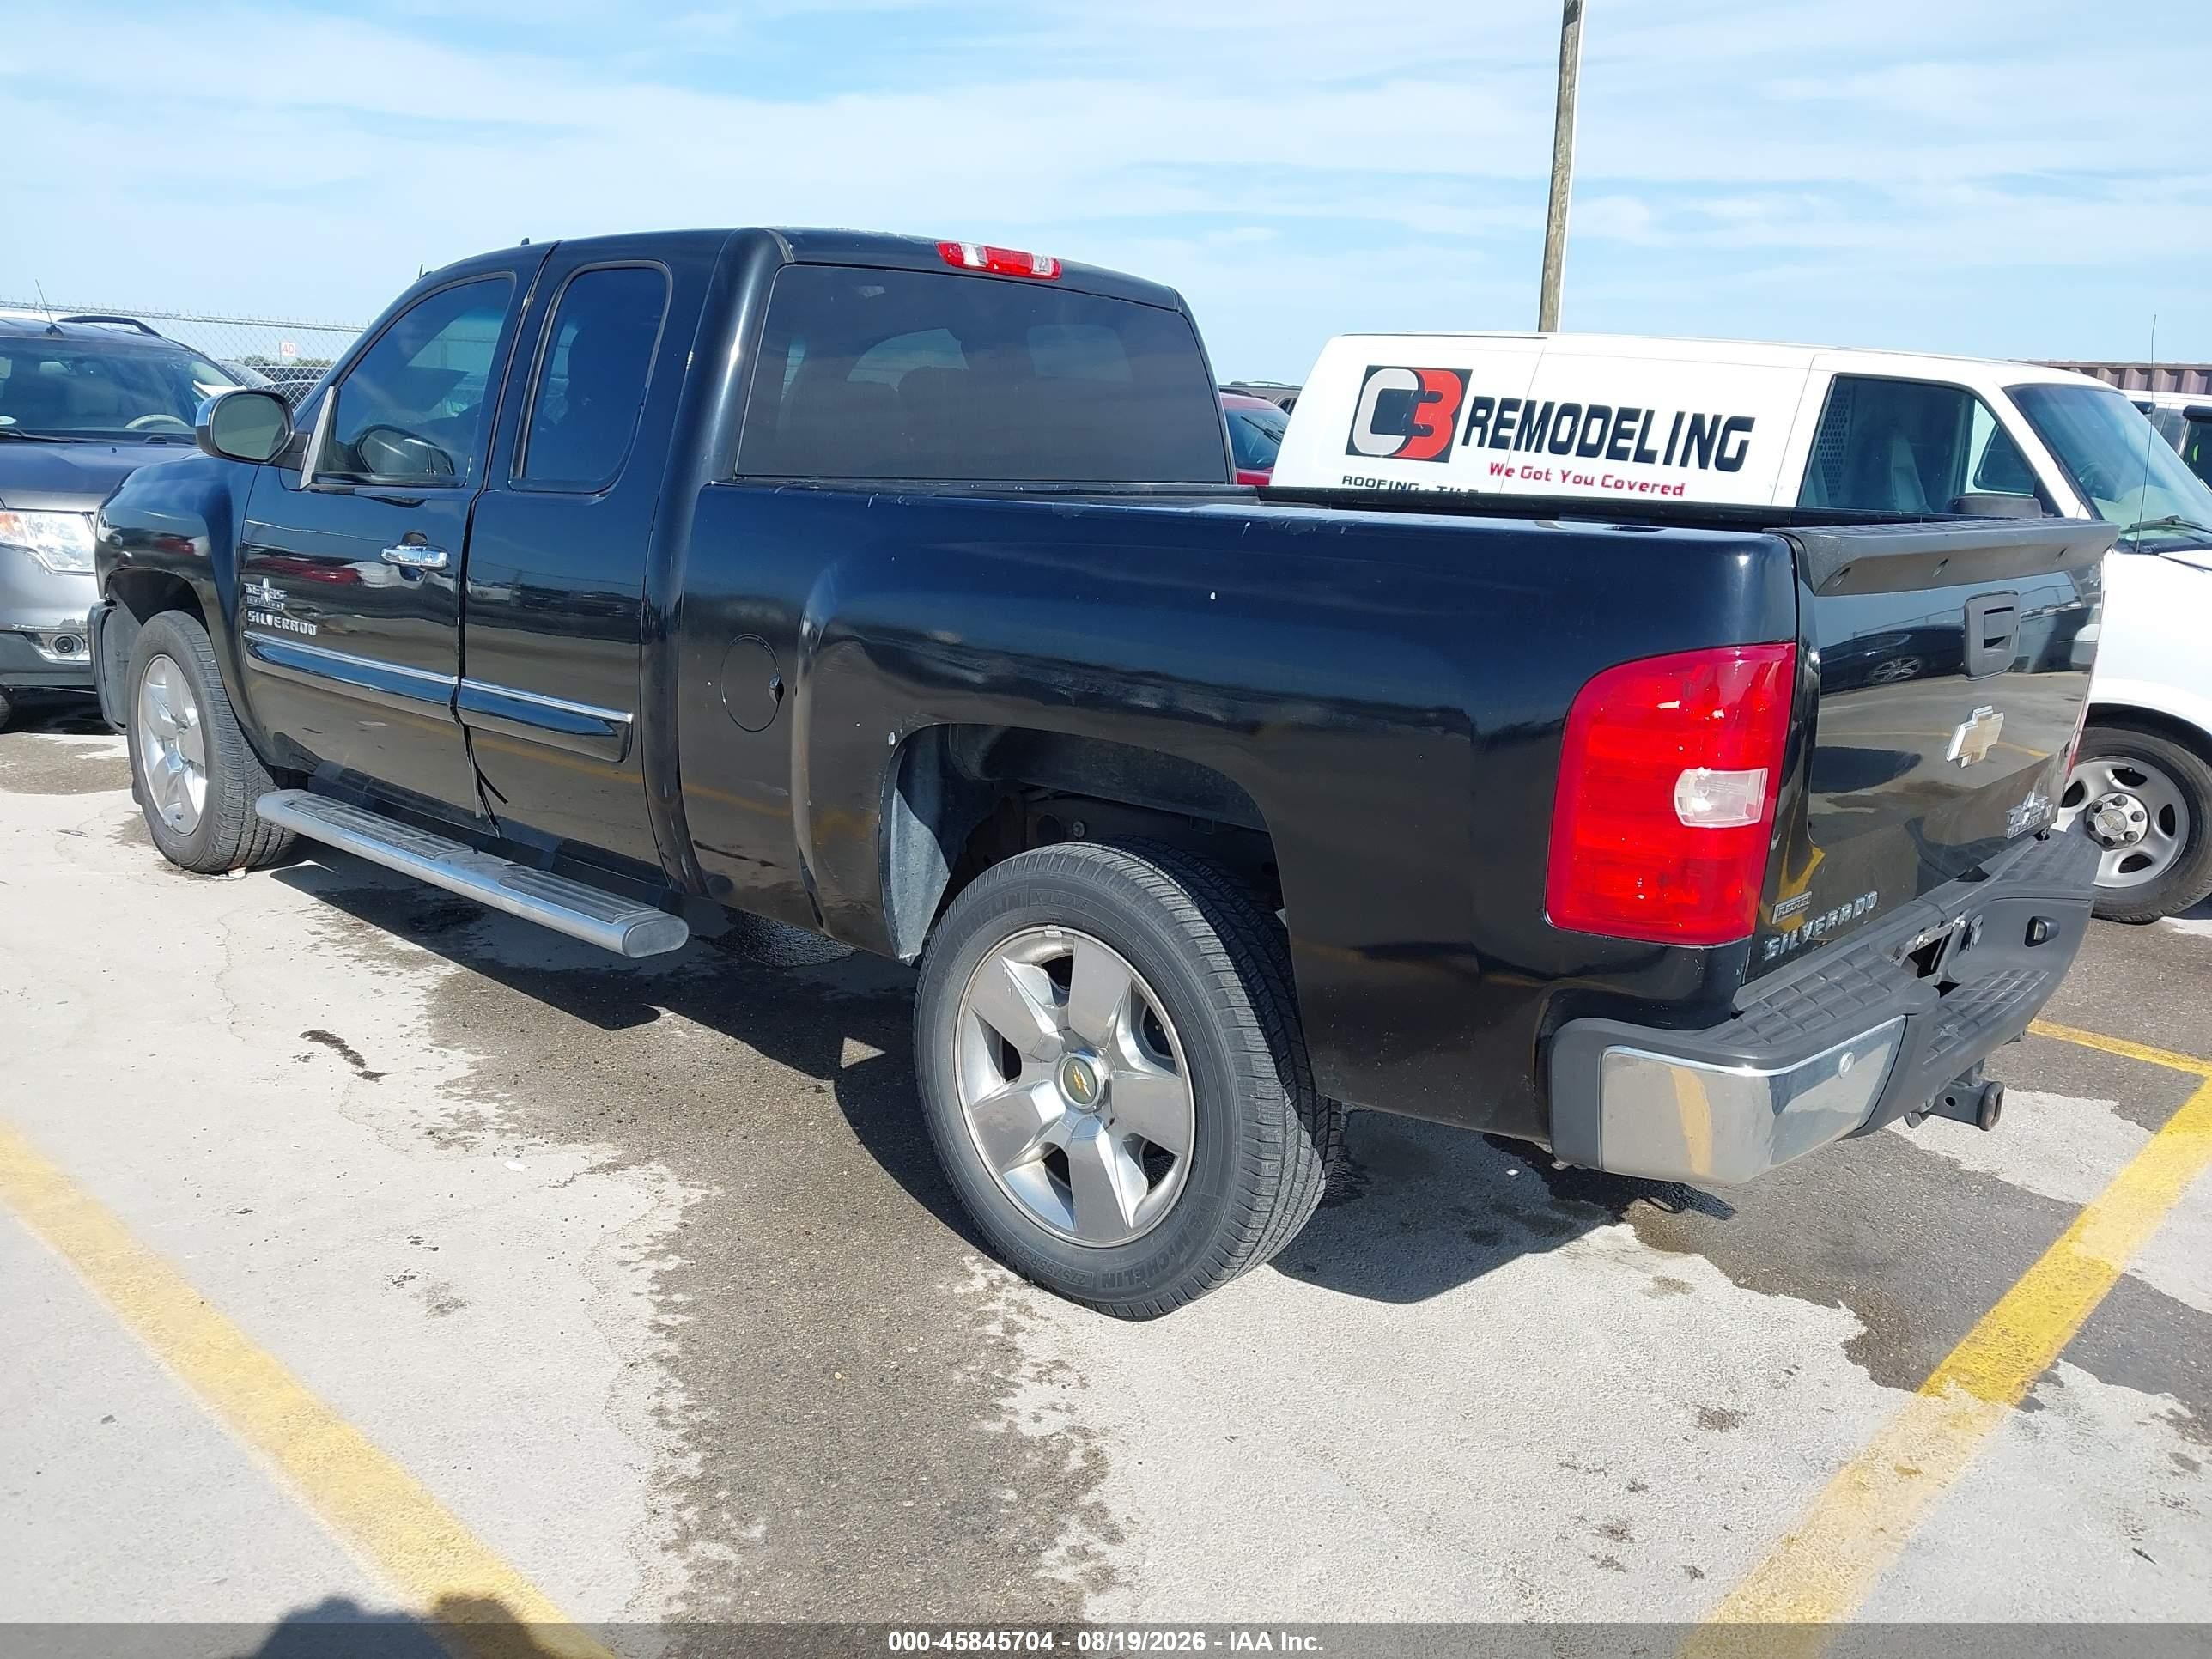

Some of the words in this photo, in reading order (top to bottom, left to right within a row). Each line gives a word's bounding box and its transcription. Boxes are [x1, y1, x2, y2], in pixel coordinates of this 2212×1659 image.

[1352, 368, 1462, 459] C3
[1462, 396, 1756, 472] REMODELING
[1489, 462, 1515, 477] We
[1520, 465, 1552, 482] Got
[1560, 469, 1595, 487] You
[1601, 474, 1685, 496] Covered
[248, 611, 318, 635] SILVERADO
[1761, 890, 1878, 961] SILVERADO
